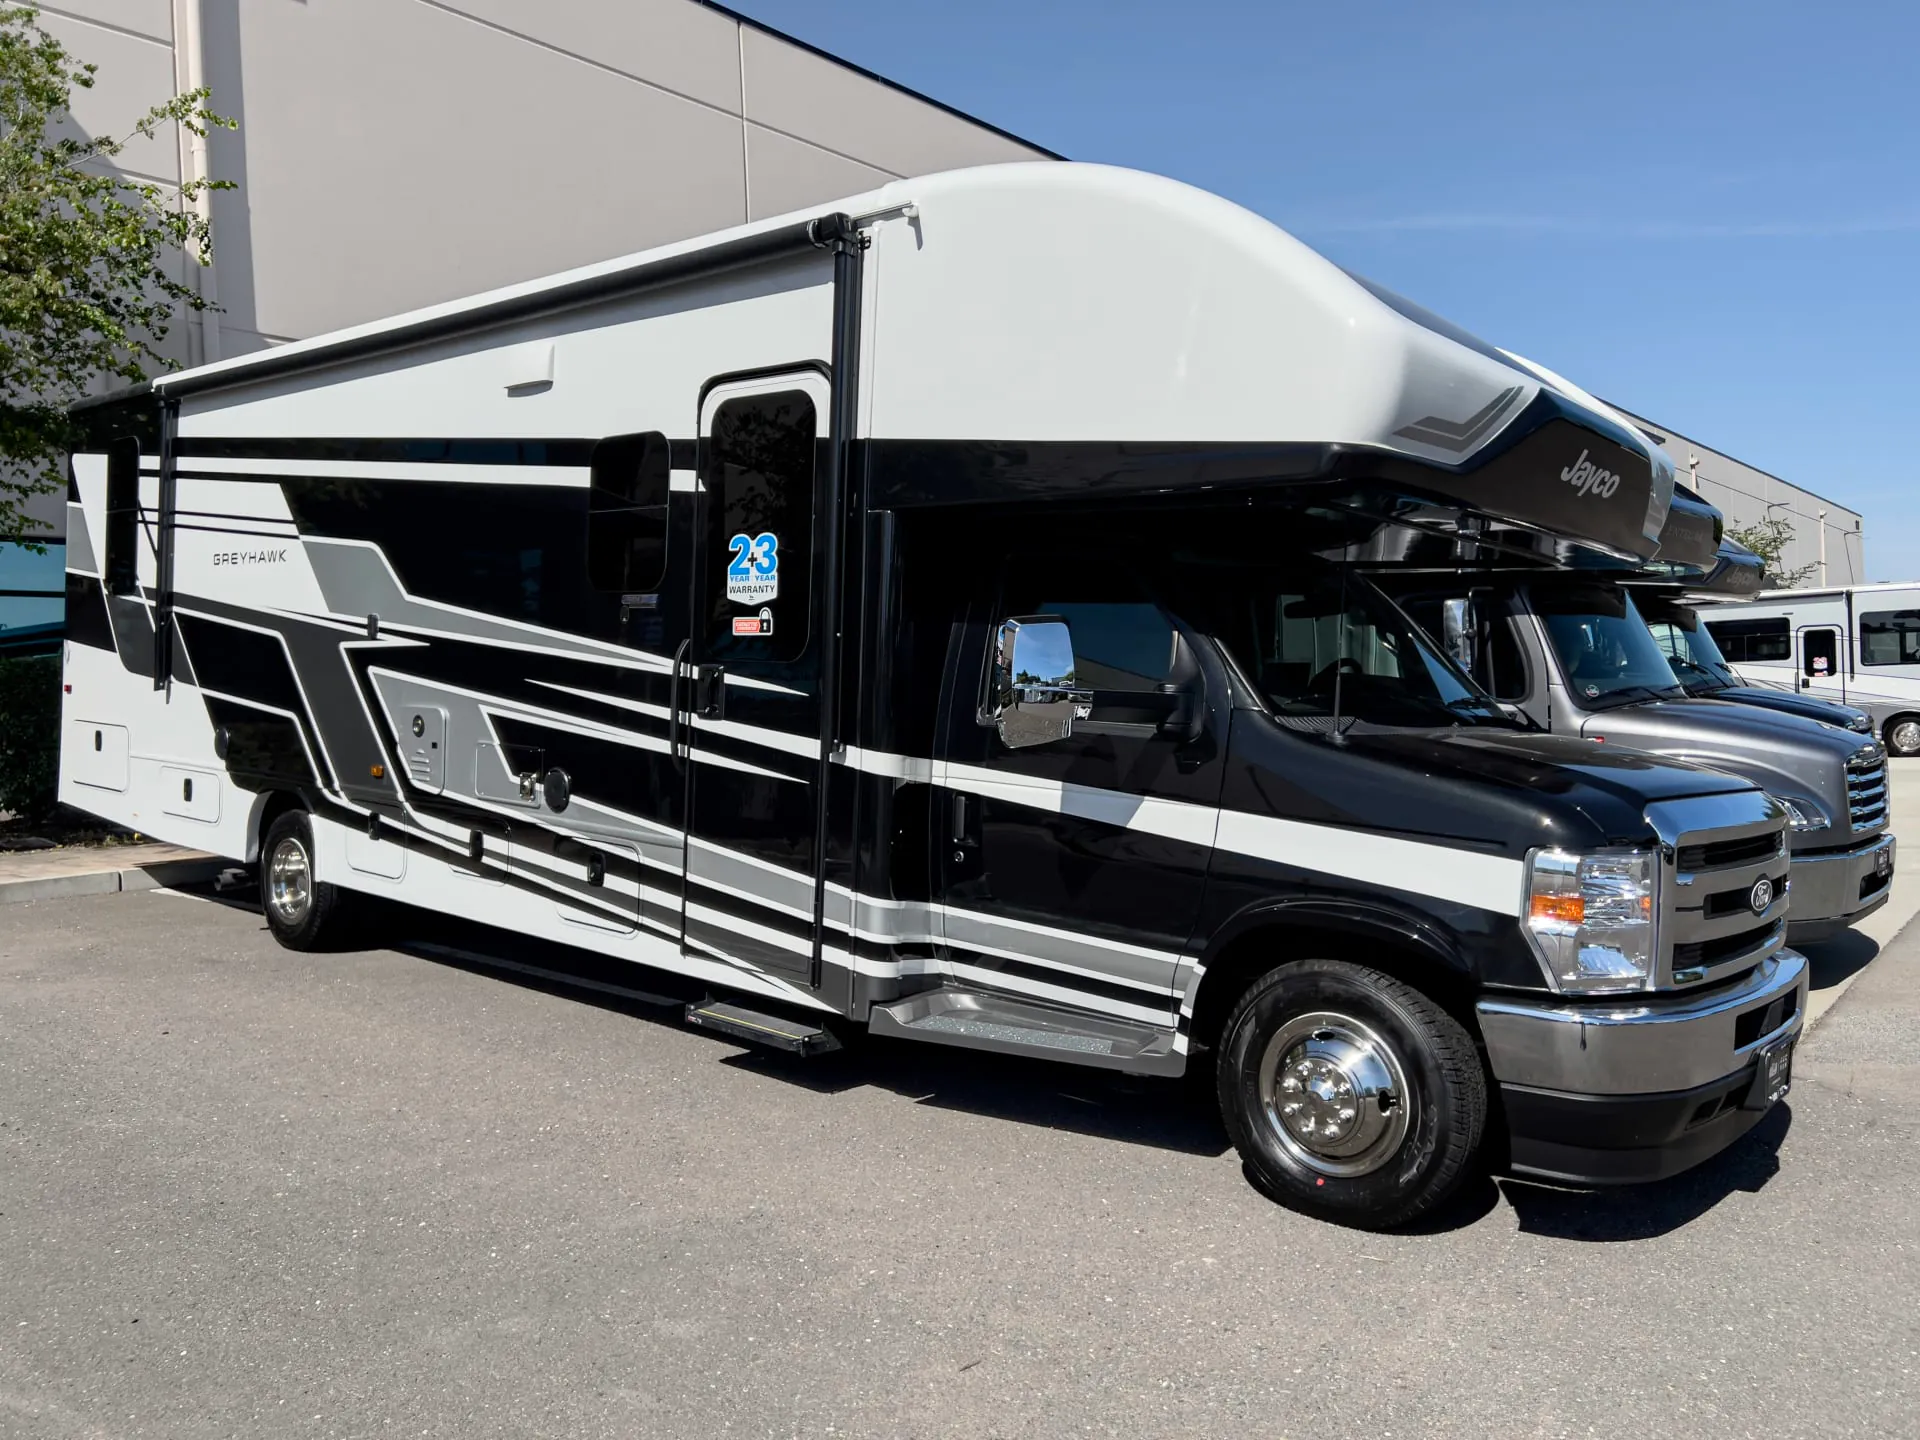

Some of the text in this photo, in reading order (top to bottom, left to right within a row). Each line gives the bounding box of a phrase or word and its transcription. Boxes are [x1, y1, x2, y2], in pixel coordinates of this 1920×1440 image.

[1560, 448, 1620, 498] Jayco
[213, 549, 287, 566] GREYHAWK
[729, 584, 775, 595] WARRANTY
